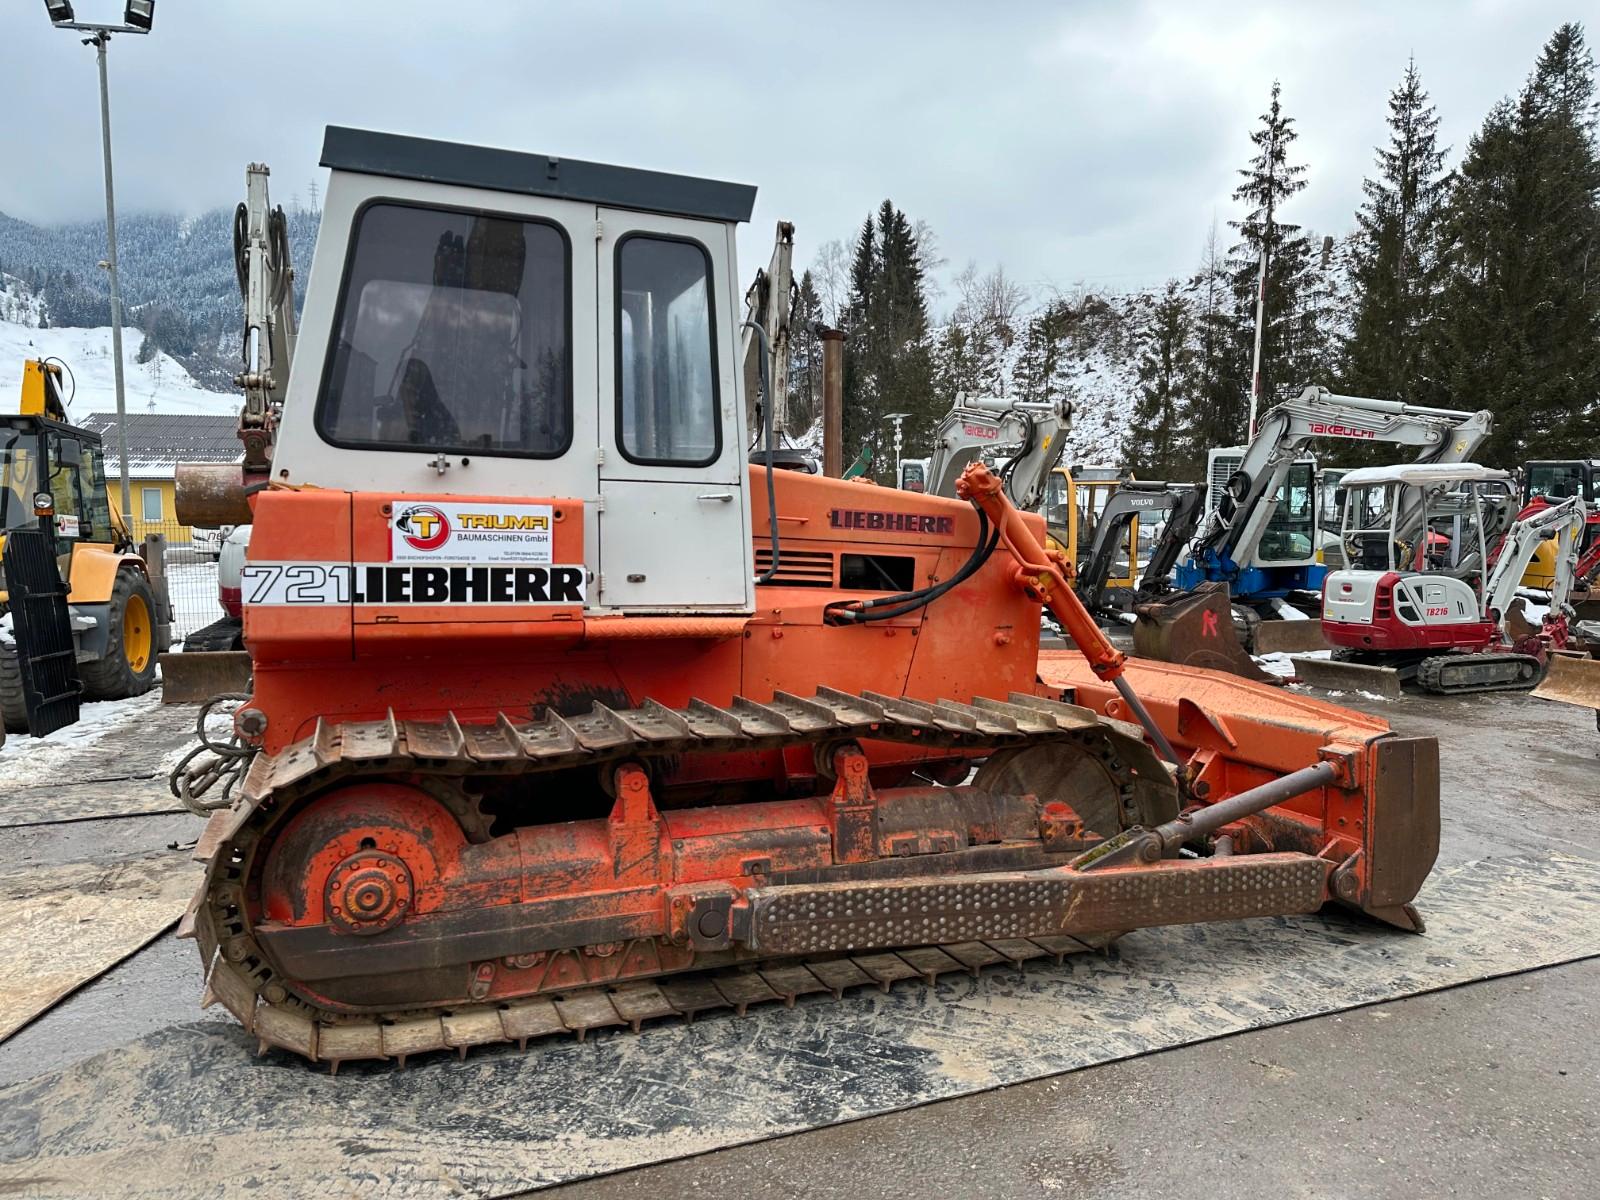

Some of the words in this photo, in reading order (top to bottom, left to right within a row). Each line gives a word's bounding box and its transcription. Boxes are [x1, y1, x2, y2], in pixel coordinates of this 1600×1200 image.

[1131, 498, 1154, 507] VOLVO
[457, 514, 549, 531] TRIUMFI
[832, 510, 953, 534] LIEBHERR
[457, 534, 523, 542] BAUMASCHINEN
[524, 535, 548, 543] GmbH
[244, 565, 351, 603] 721
[352, 566, 585, 603] LIEBHERR
